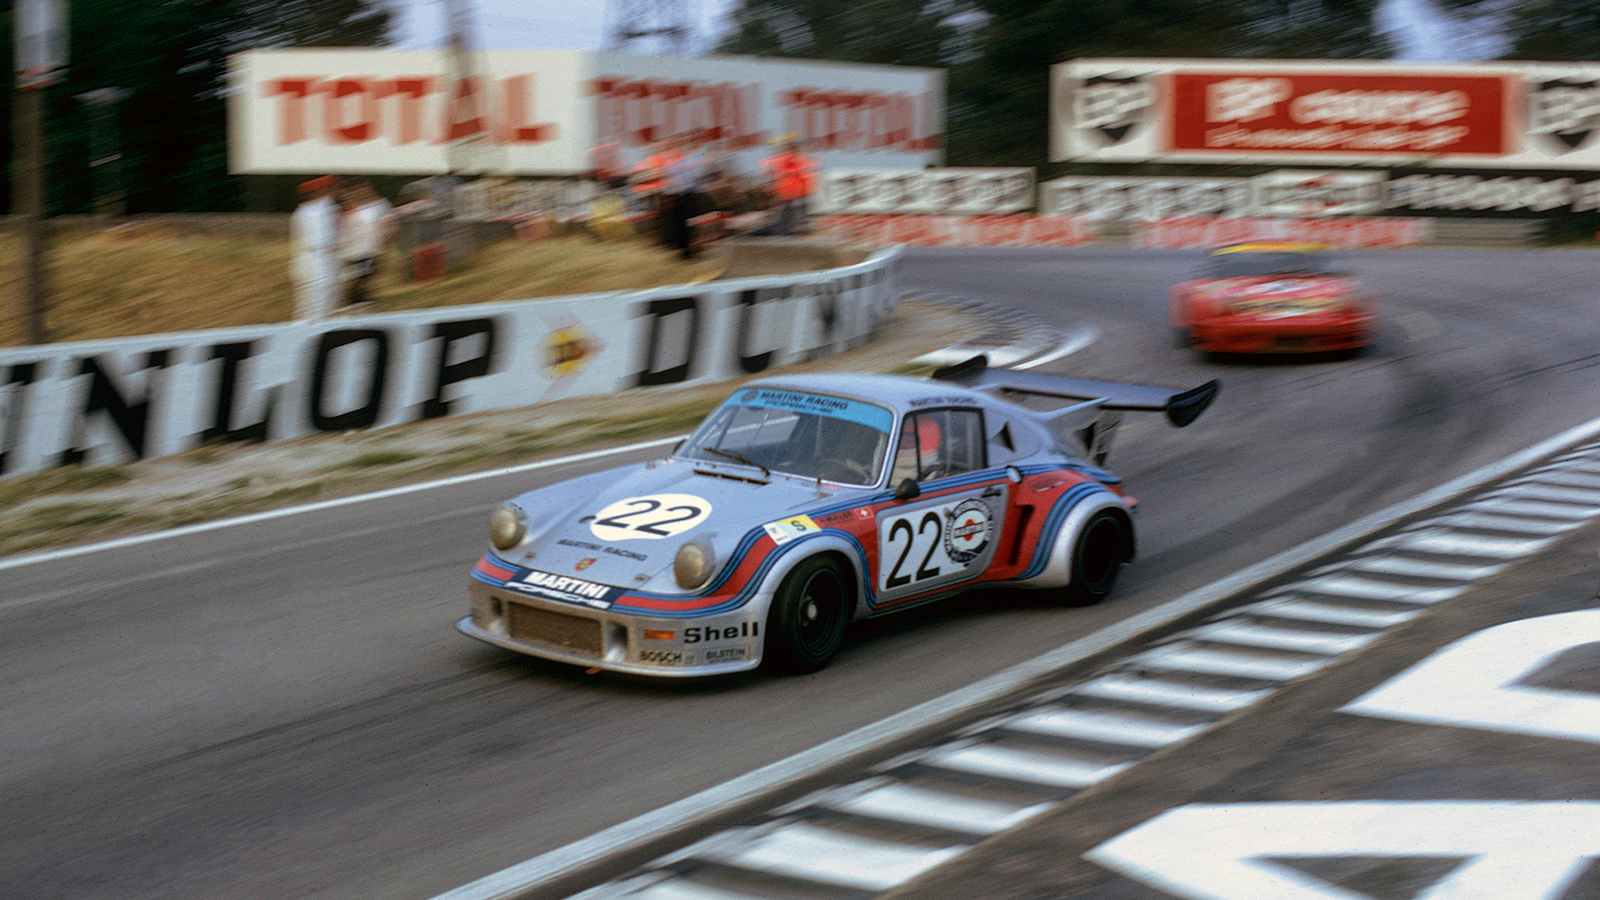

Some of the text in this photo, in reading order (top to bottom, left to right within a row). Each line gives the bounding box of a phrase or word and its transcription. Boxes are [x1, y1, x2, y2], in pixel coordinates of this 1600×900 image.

[258, 74, 562, 147] TOTAL
[1204, 78, 1294, 123] BP
[760, 391, 801, 403] MARTINI
[806, 396, 849, 410] RACING
[595, 500, 702, 536] 22
[790, 519, 807, 532] S
[886, 511, 943, 589] 22
[523, 571, 611, 599] MARTINI
[684, 621, 759, 644] Shell
[640, 650, 682, 663] BOSCH
[706, 648, 746, 660] BILSTEIN
